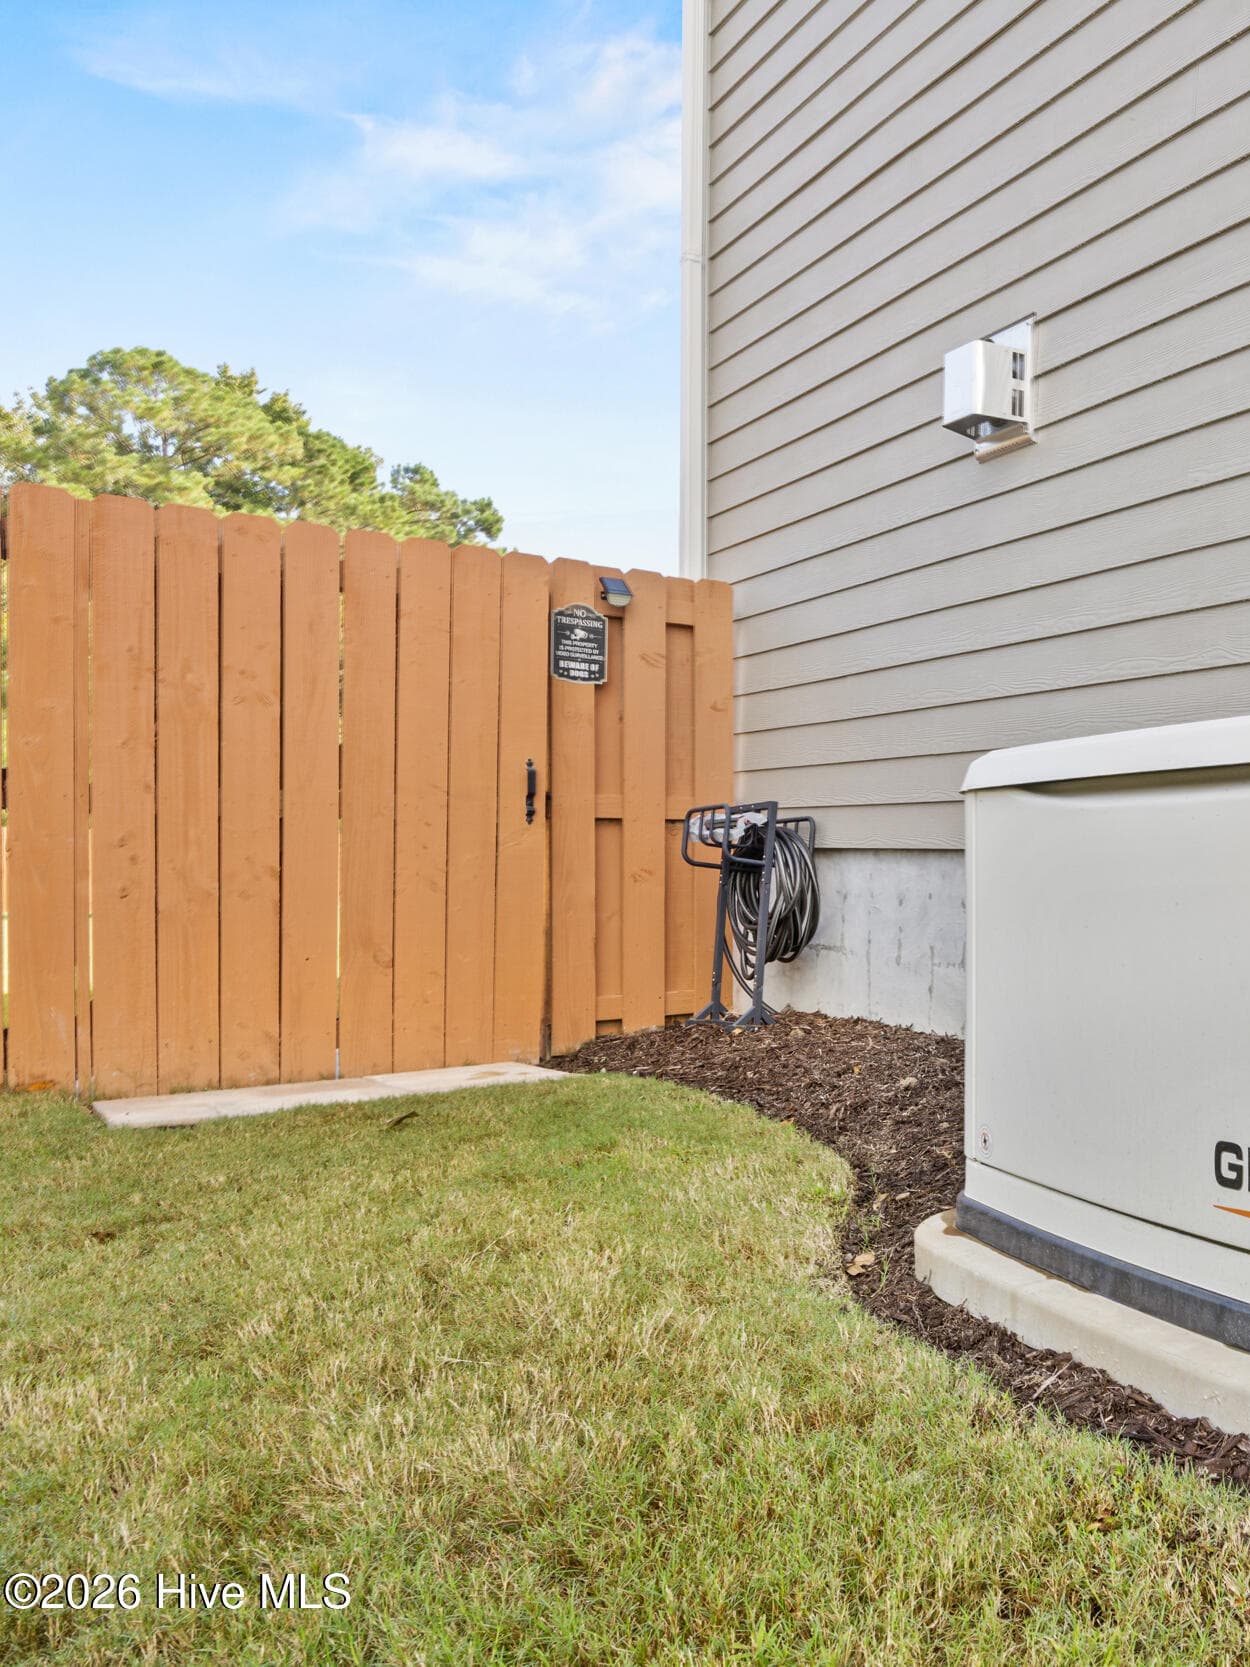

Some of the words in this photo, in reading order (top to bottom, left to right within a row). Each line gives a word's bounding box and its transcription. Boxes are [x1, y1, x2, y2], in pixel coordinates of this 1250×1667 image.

[573, 609, 586, 617] NO
[557, 616, 603, 628] TRESPASSING
[559, 660, 589, 670] BEWARE
